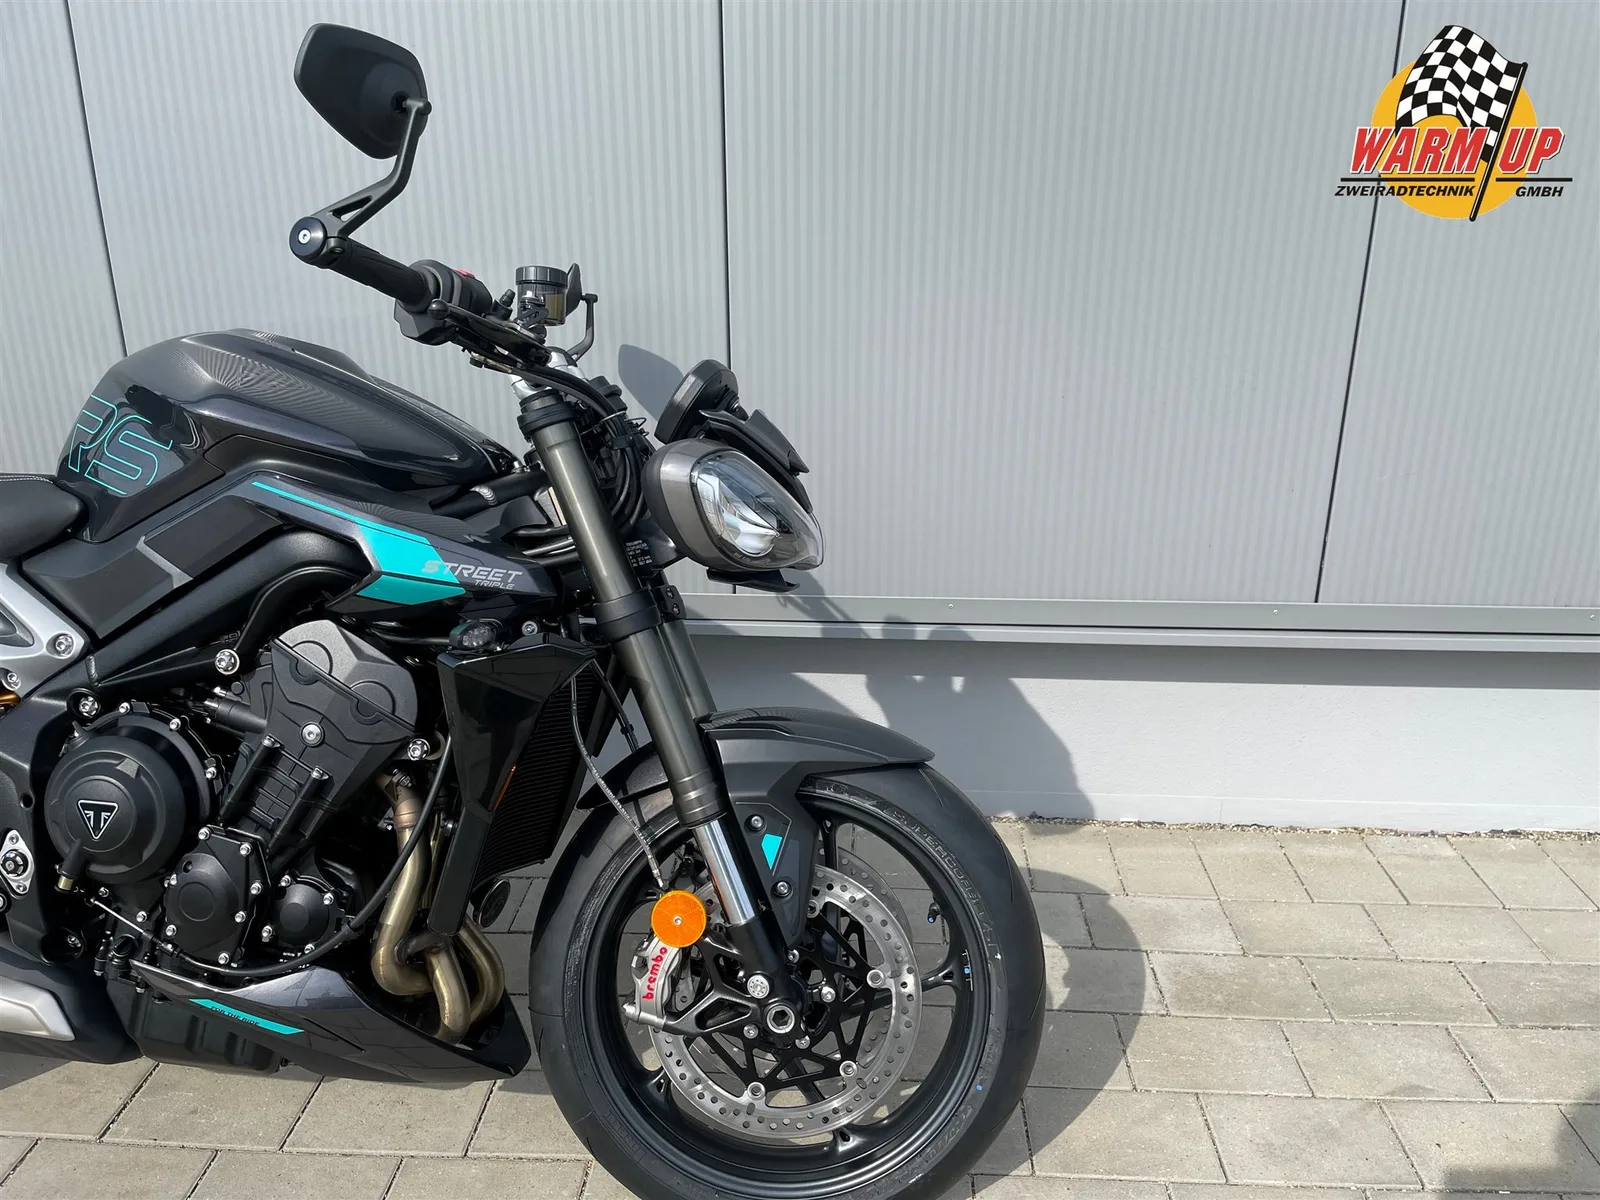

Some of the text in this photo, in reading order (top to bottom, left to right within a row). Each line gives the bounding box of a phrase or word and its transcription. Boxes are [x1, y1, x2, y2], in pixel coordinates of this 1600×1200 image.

[422, 560, 523, 583] STREET
[474, 579, 515, 590] TRIPLE
[642, 946, 668, 1001] brembo
